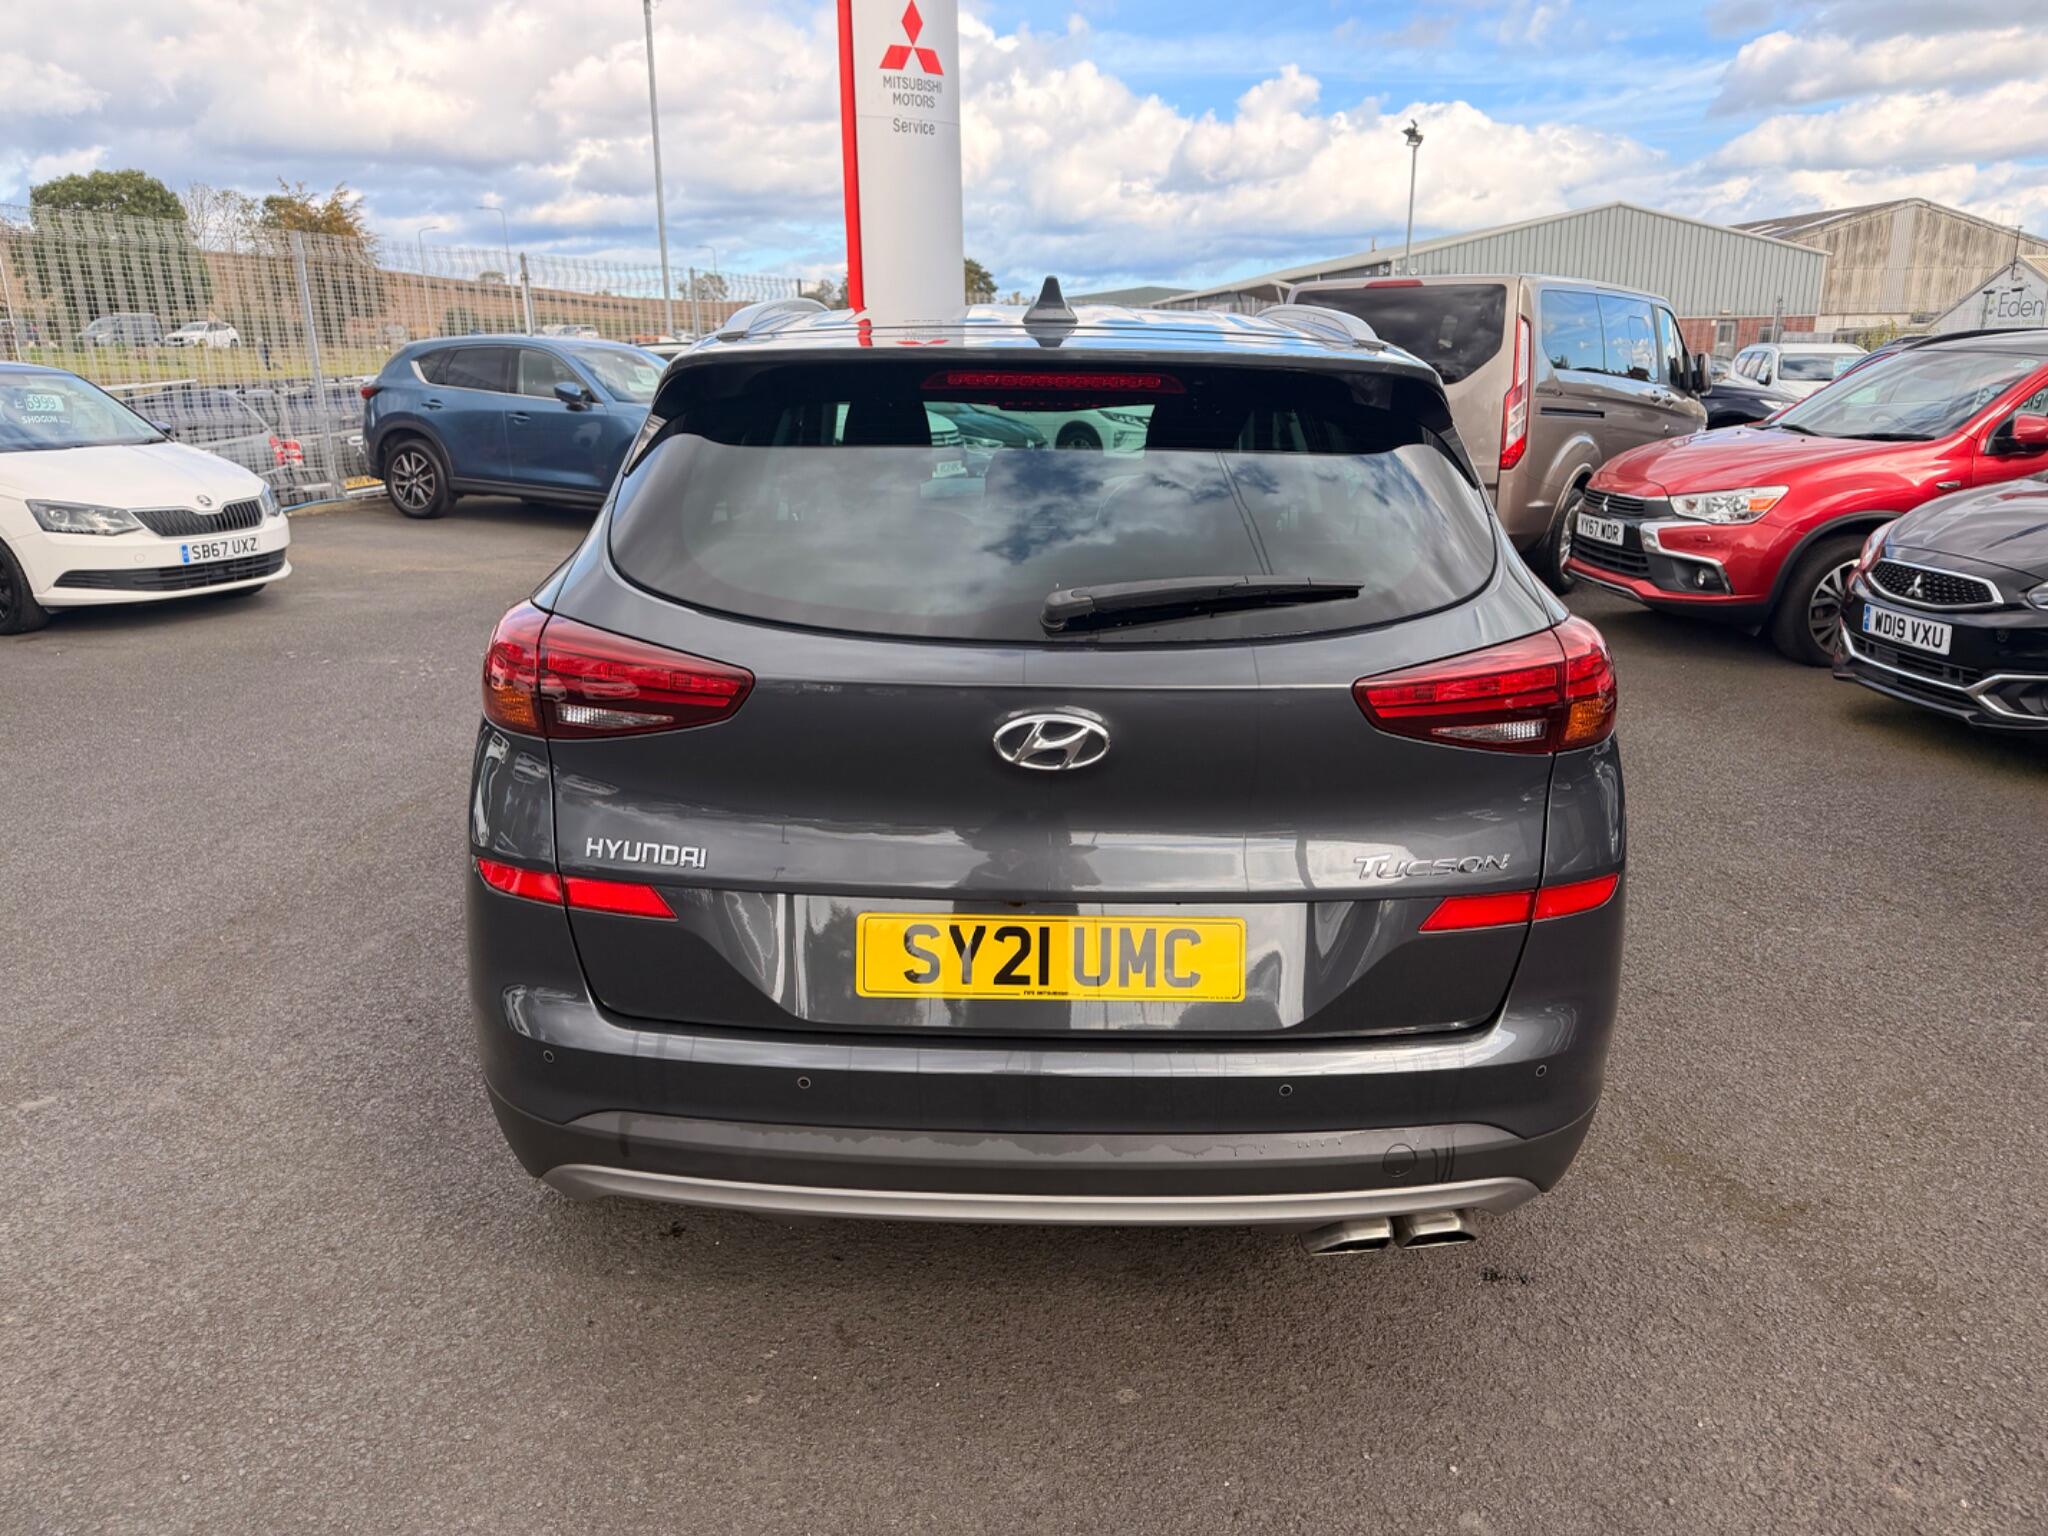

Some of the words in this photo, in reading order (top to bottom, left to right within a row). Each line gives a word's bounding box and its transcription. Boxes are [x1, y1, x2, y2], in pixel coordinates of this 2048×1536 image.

[883, 75, 942, 93] MITSUBISHI
[893, 92, 935, 109] MOTORS
[893, 117, 935, 135] Service
[1998, 289, 2044, 318] Eden
[192, 541, 228, 560] SB67
[232, 537, 257, 554] UXZ
[1875, 610, 1906, 638] WD19
[1911, 620, 1944, 648] VXU
[585, 836, 707, 869] HYUNDAI
[1354, 853, 1511, 880] TUCSON
[903, 923, 1050, 986] SY21
[1073, 926, 1202, 989] UMC
